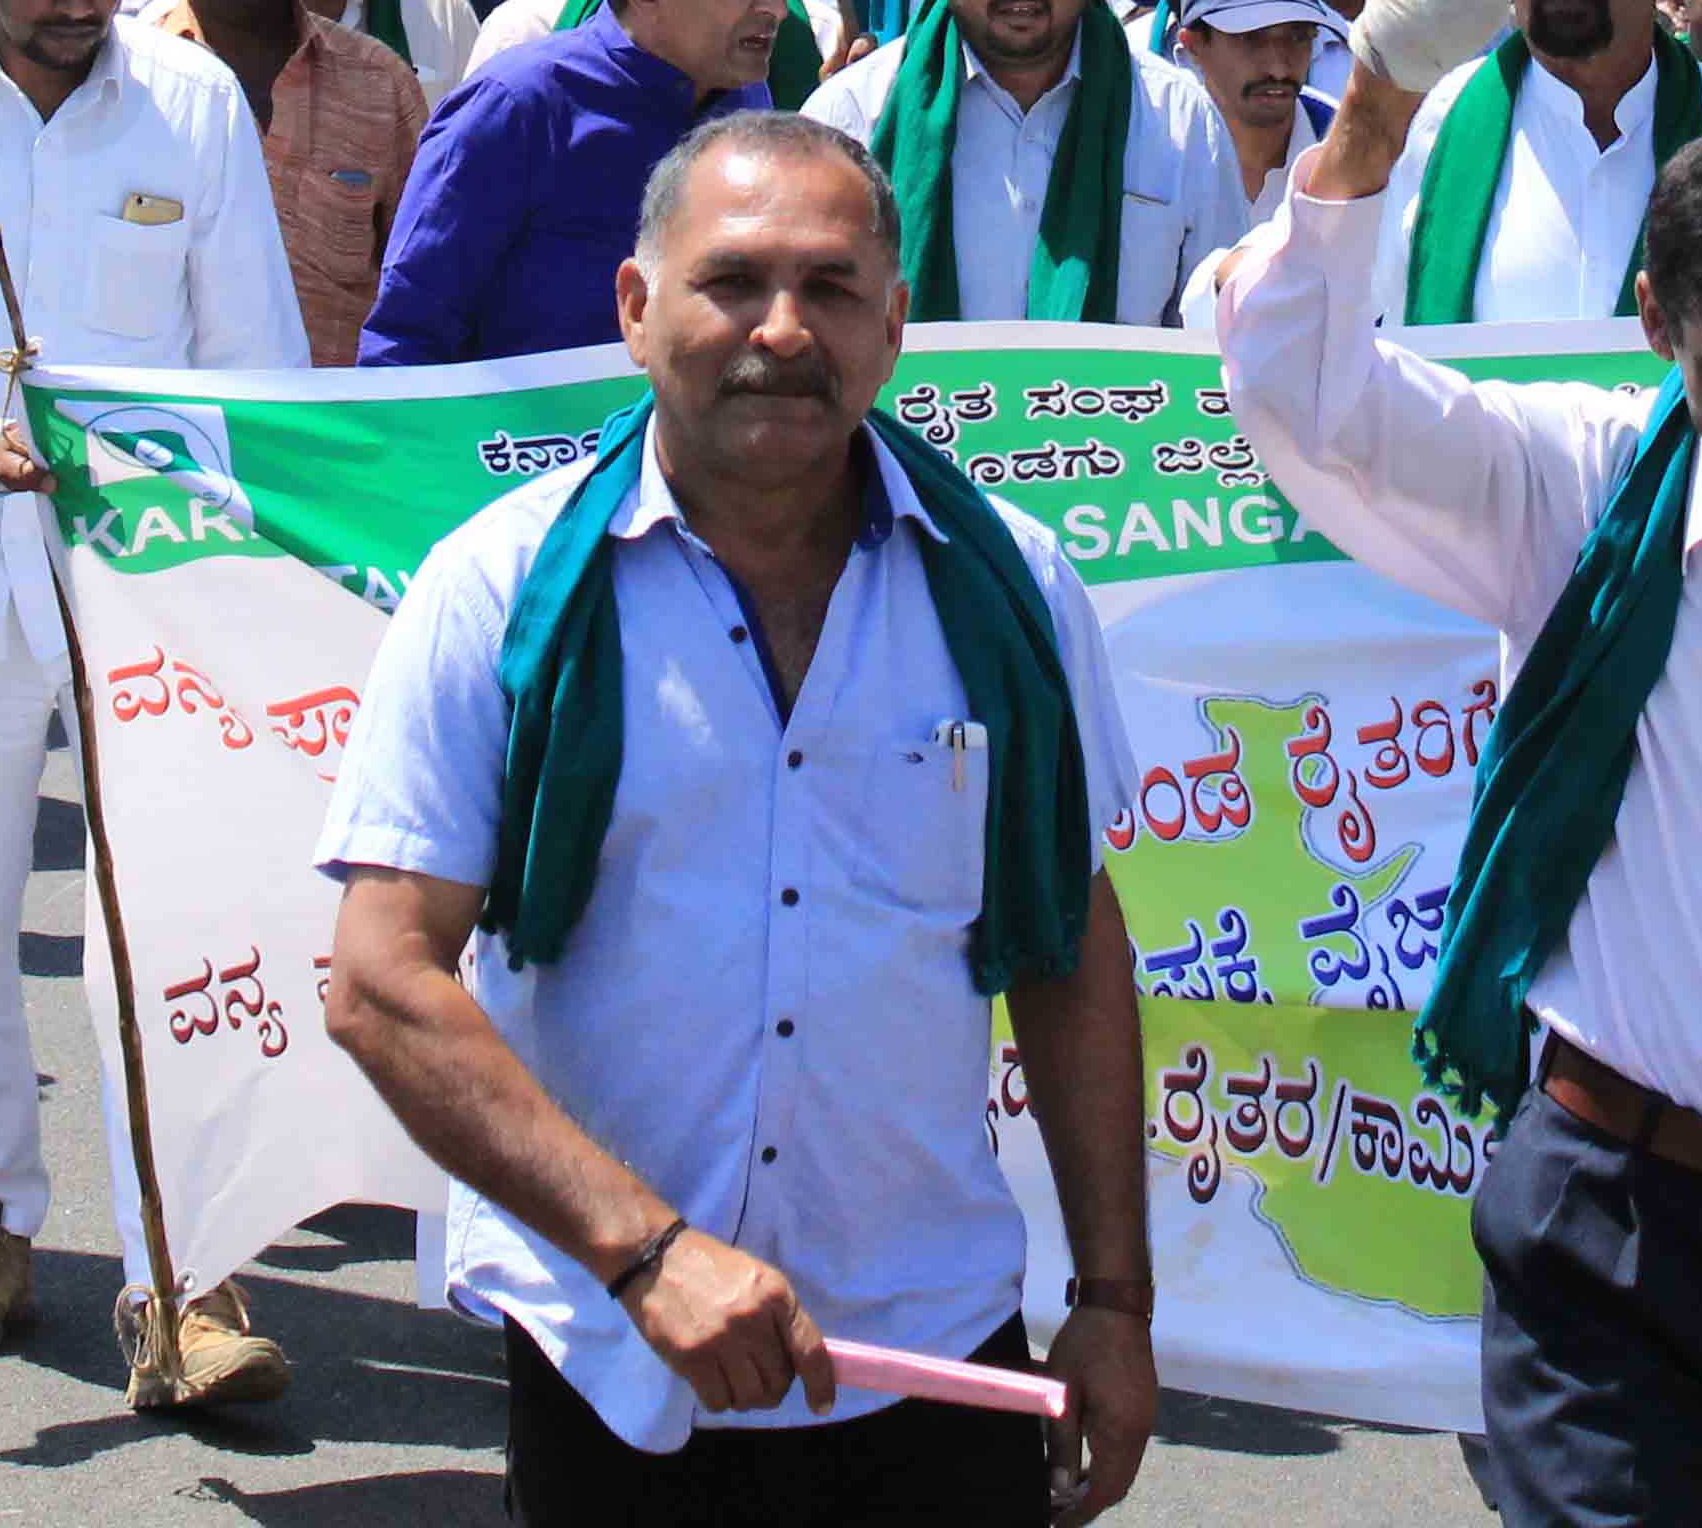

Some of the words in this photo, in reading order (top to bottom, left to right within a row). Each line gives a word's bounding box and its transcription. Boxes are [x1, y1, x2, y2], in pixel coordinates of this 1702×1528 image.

[899, 384, 994, 445] ರೈತ
[107, 643, 254, 750] ವನ್ಯ
[164, 944, 289, 1058] ವನ್ಯ
